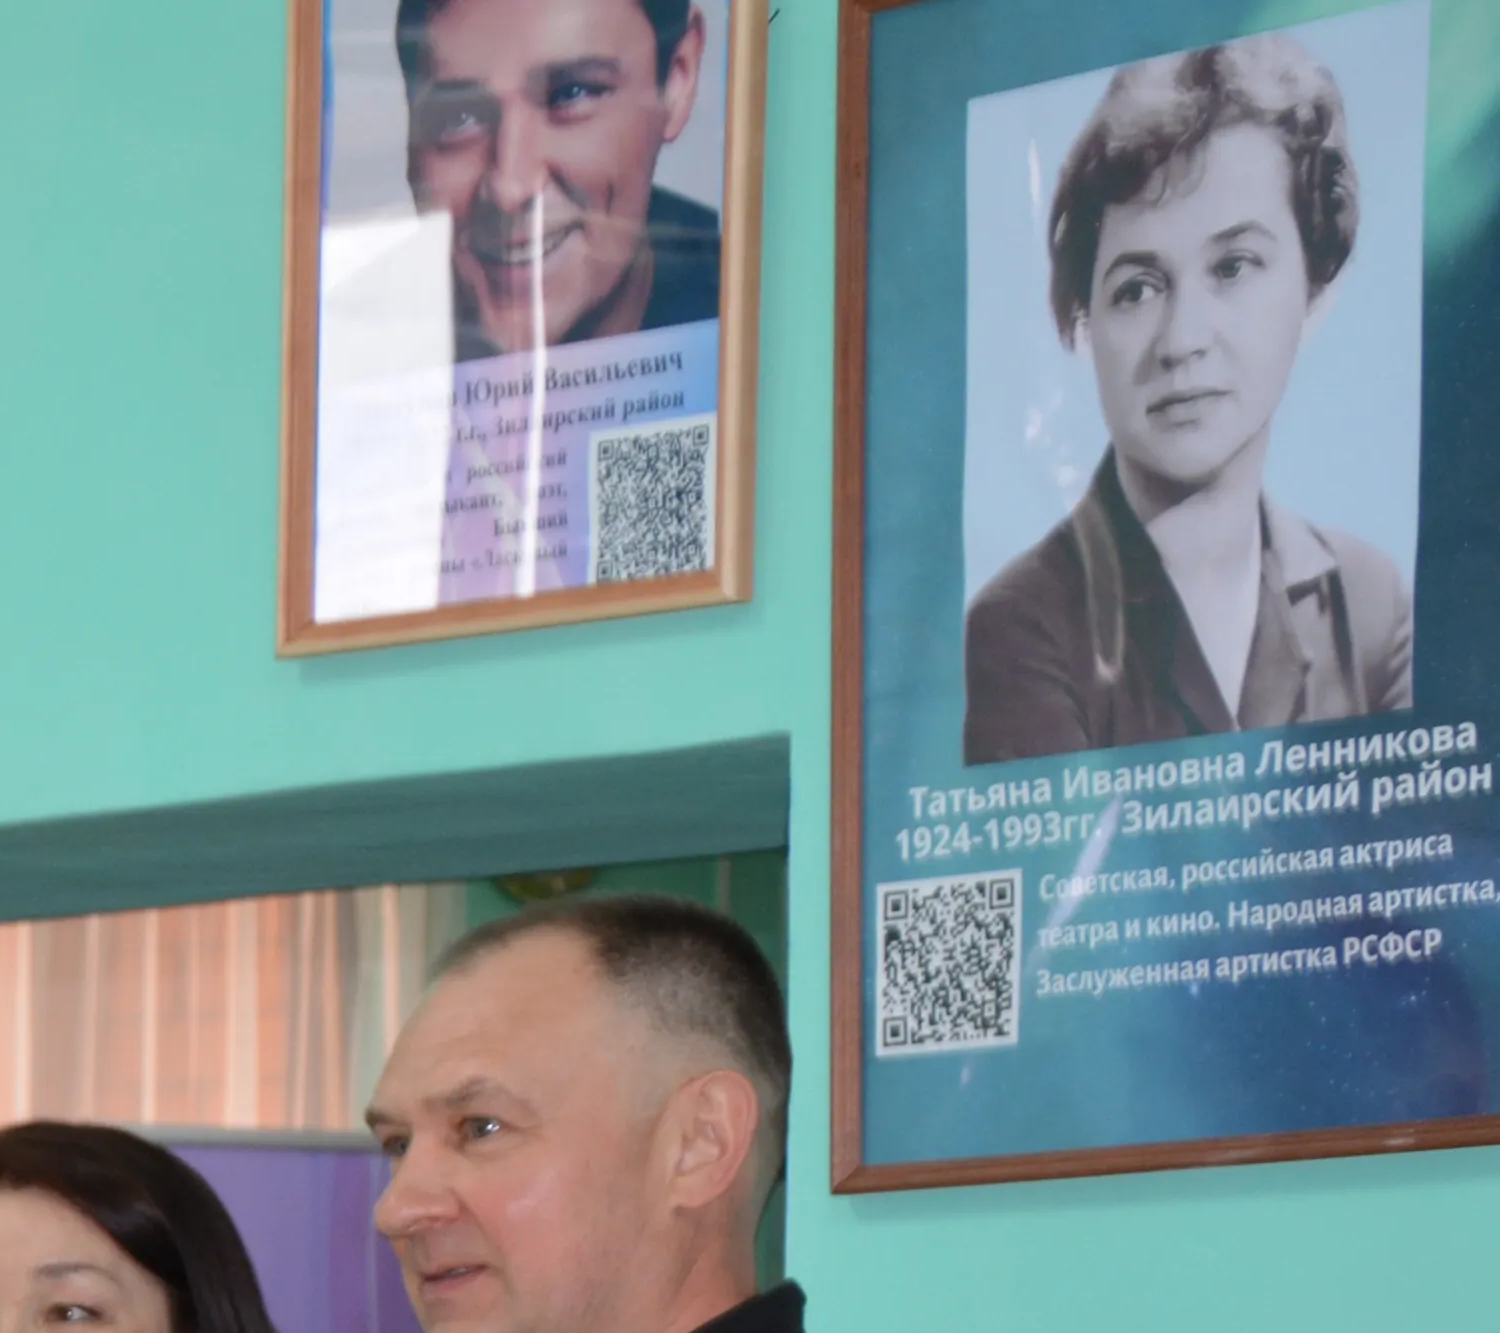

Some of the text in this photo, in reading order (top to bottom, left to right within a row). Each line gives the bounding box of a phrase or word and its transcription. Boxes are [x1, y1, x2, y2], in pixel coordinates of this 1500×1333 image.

[542, 351, 684, 391] Васильевич
[496, 395, 616, 437] Зилирский
[622, 390, 685, 422] район
[909, 720, 1478, 819] Татьяна Ивановна Ленникова
[1121, 770, 1360, 834] Зилаирский
[1370, 759, 1493, 814] район
[1040, 833, 1453, 900] Советская, российская актриса
[1037, 878, 1500, 949] театра и кино. Народная артистка,
[1036, 927, 1442, 998] Заслуженная артистка РСФСР
